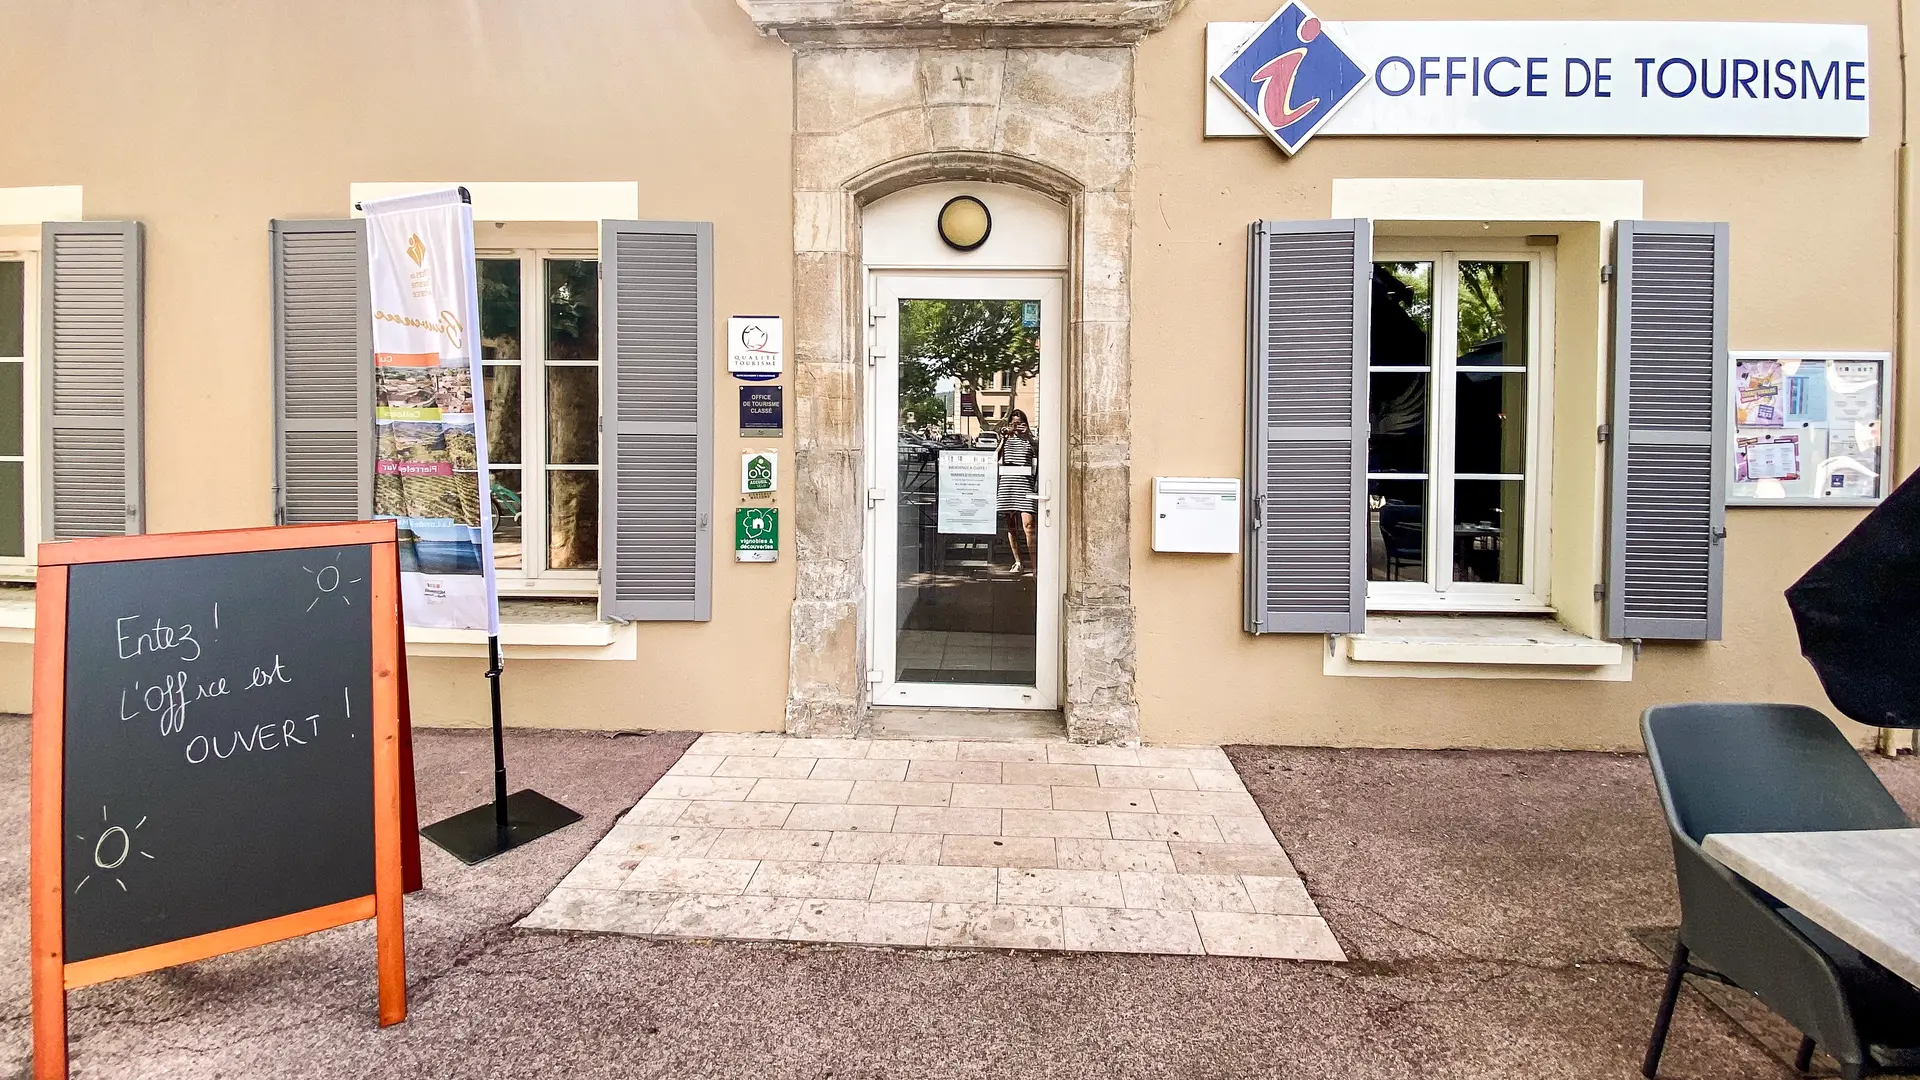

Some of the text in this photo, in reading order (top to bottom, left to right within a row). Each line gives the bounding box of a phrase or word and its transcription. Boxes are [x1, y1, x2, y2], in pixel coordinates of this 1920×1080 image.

[1374, 55, 1866, 101] OFFICE DE TOURISME
[117, 615, 201, 662] Entez
[245, 655, 292, 690] est
[186, 714, 320, 764] OUVERT
